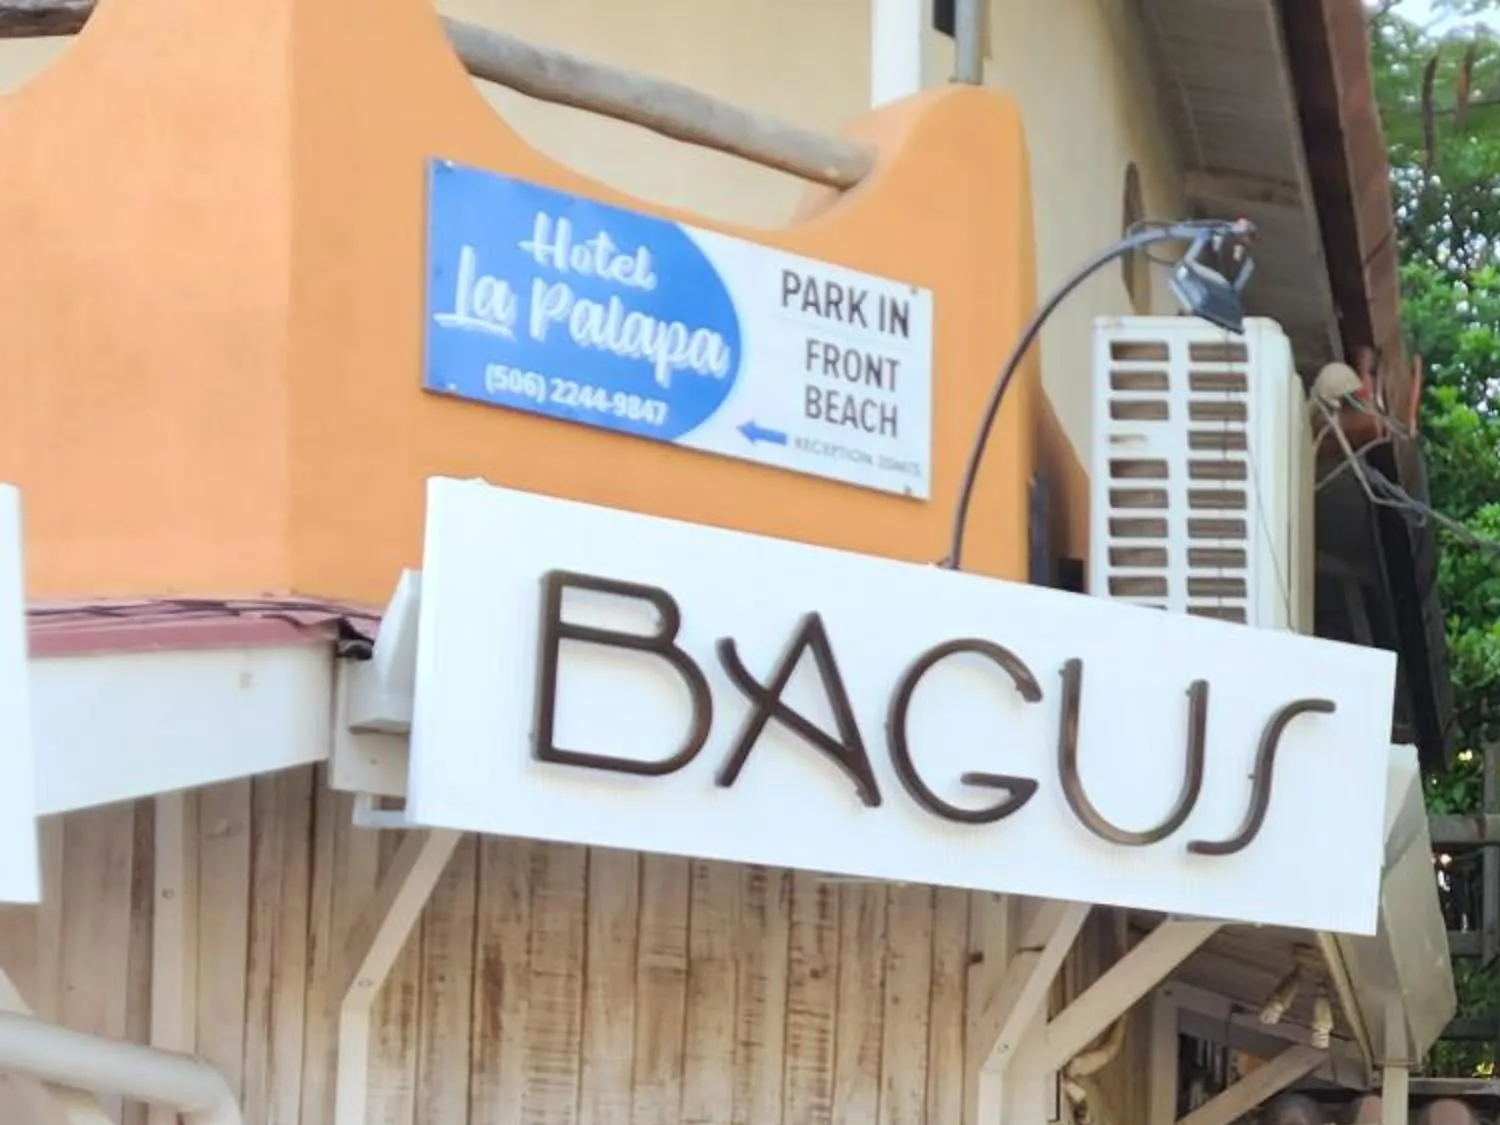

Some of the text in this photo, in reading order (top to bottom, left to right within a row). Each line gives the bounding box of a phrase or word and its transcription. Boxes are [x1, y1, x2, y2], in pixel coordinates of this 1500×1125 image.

[517, 211, 657, 290] Hotel
[432, 245, 731, 388] La Palapa
[781, 269, 909, 338] PARK IN
[485, 363, 668, 425] (506) 2244-9847
[806, 338, 900, 392] FRONT
[805, 384, 898, 438] BEACH
[532, 569, 1336, 857] BAGUS
